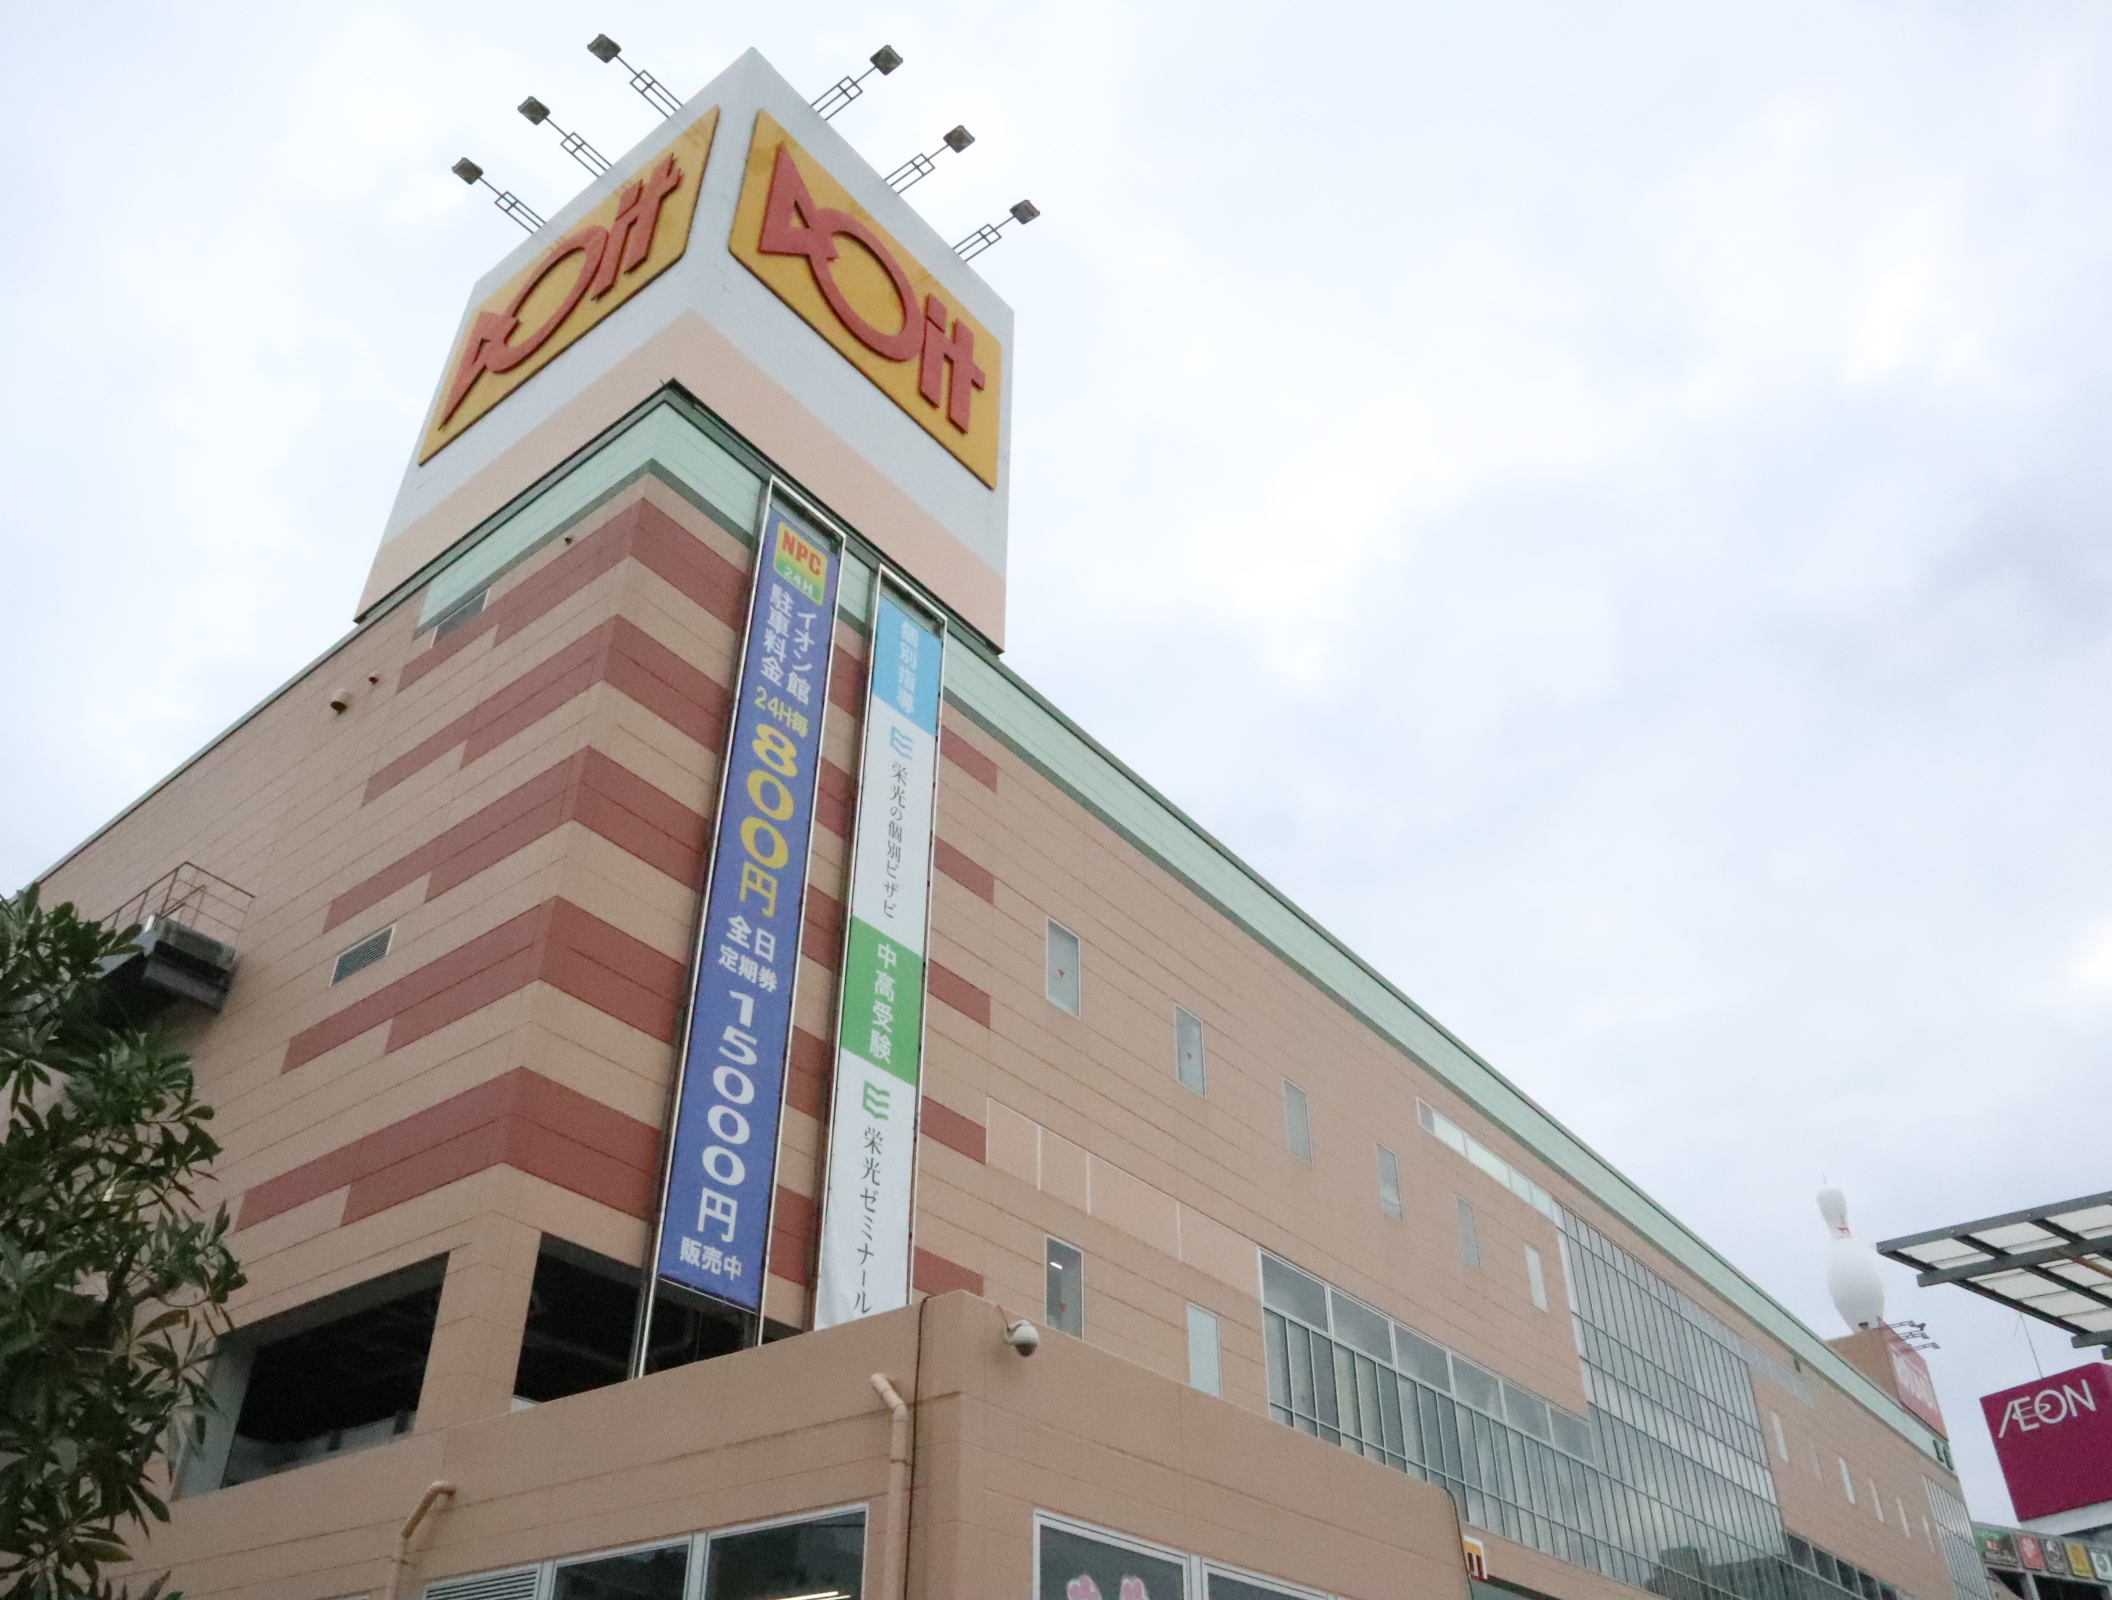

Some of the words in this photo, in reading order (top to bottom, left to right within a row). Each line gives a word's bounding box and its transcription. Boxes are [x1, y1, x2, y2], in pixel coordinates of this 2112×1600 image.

[781, 529, 821, 576] NPC
[760, 583, 794, 687] 駐車料金
[786, 611, 817, 705] イオン館
[755, 685, 809, 738] 24H毎
[739, 724, 798, 917] 800円
[882, 762, 908, 920] 栄光の個別ビザビ
[718, 944, 778, 993] 定期券
[726, 915, 776, 963] 全日
[868, 943, 898, 1065] 中高受験
[697, 990, 758, 1243] 15000円
[679, 1236, 743, 1282] 販売中
[853, 1125, 884, 1316] 栄光ゼミナール
